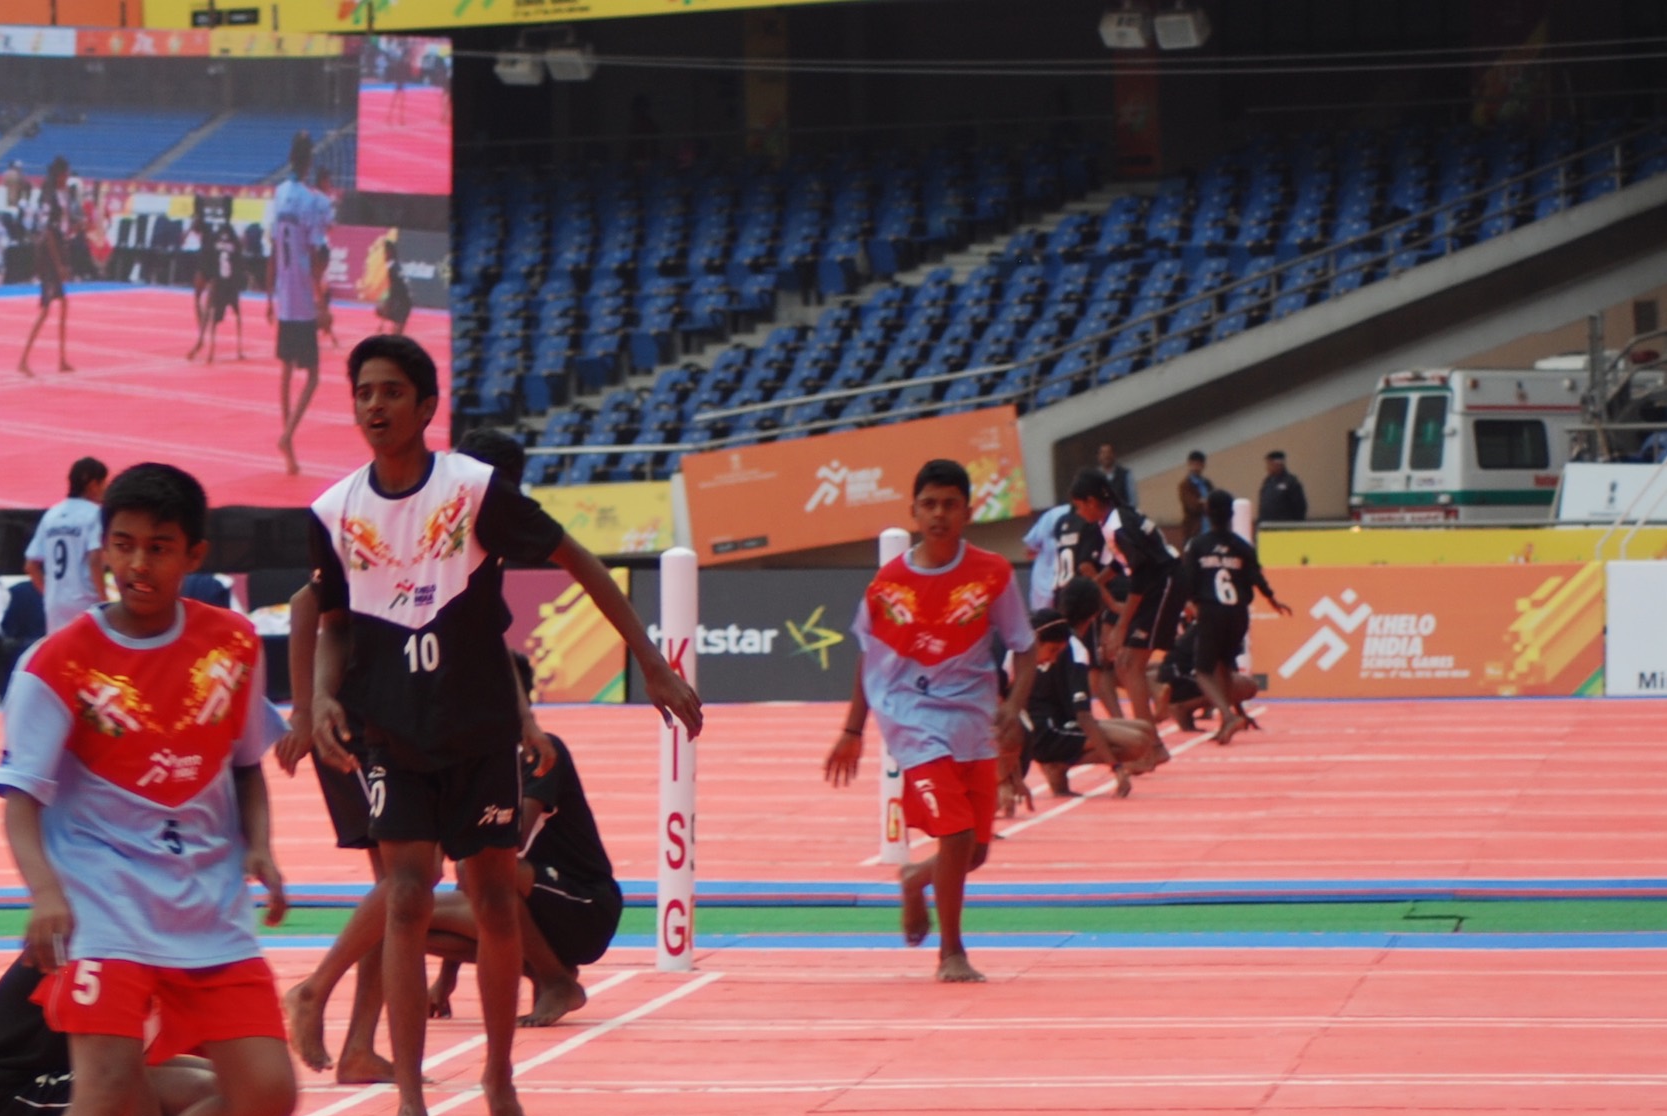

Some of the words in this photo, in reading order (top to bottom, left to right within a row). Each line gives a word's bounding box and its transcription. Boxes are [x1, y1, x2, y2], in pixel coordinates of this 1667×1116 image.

[54, 539, 68, 580] 9
[1214, 569, 1238, 605] 6
[647, 625, 779, 655] htstar
[1367, 614, 1436, 636] KHELO
[404, 632, 440, 674] 10
[1361, 657, 1408, 669] SCHOOL
[1411, 656, 1454, 668] GAMES
[1363, 637, 1423, 657] INDIA
[161, 820, 183, 855] 5
[71, 960, 103, 1006] 5
